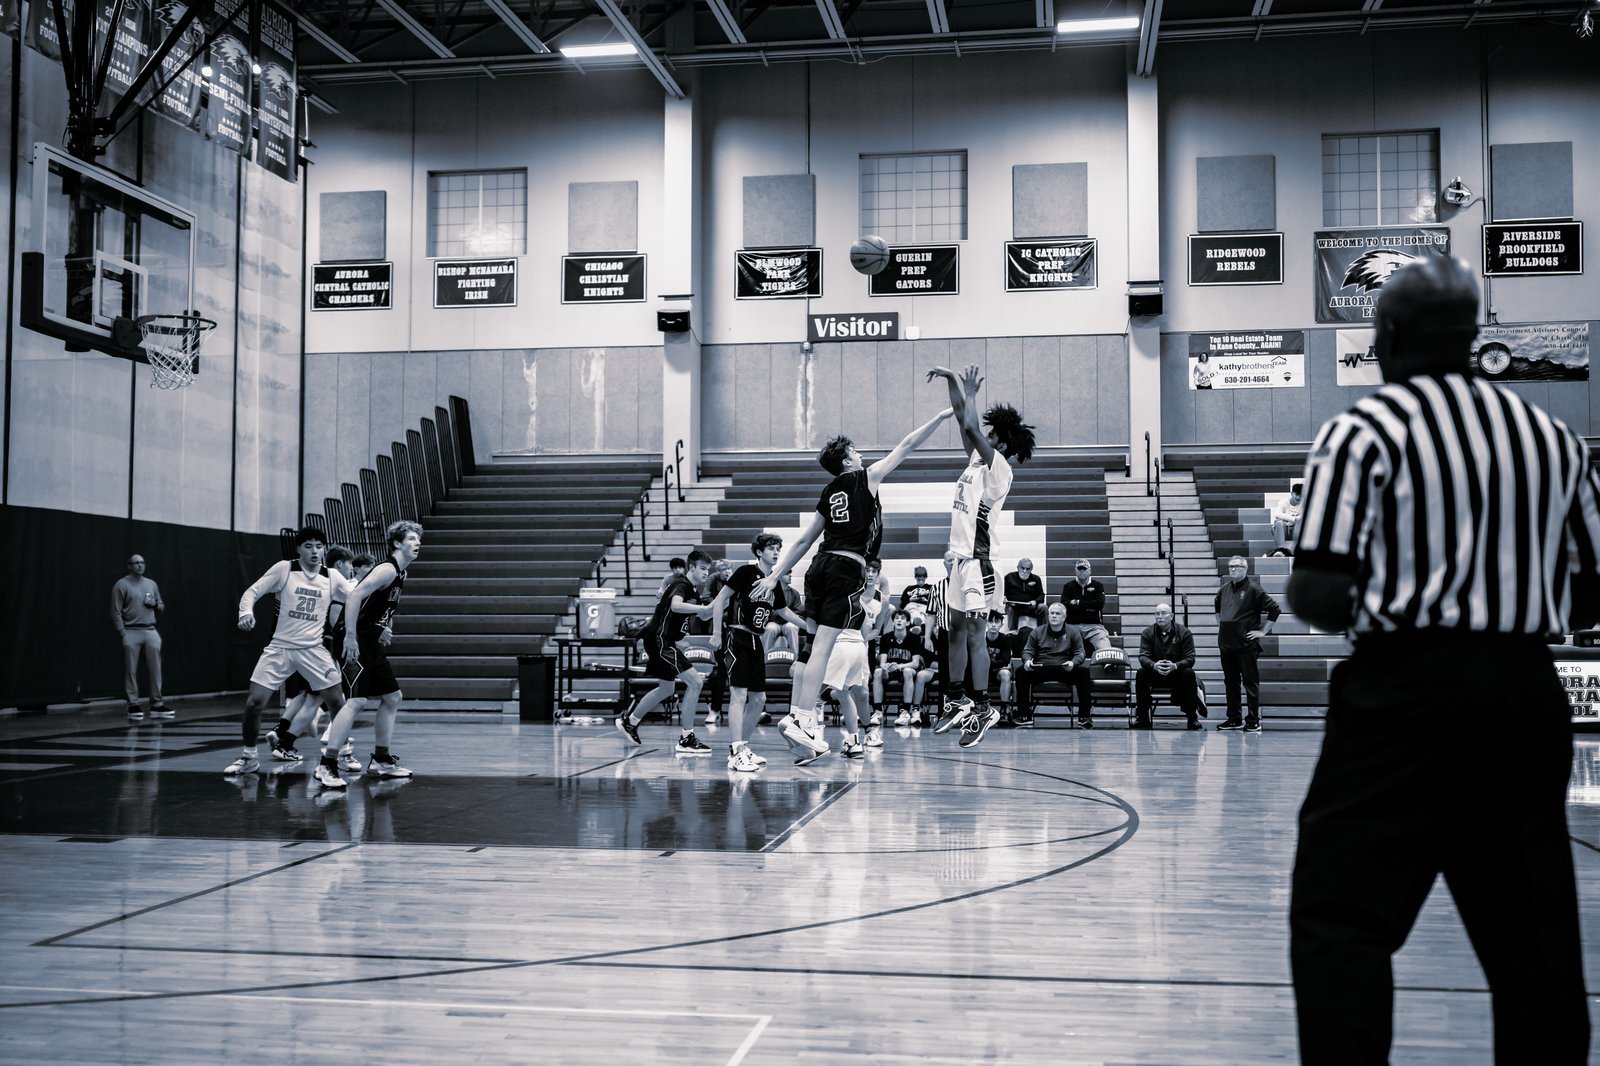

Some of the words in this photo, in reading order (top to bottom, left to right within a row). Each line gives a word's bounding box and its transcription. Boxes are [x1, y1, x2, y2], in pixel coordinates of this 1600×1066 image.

[261, 3, 294, 42] AURORA
[163, 94, 192, 118] FOOTBALL
[218, 123, 244, 144] FOOTBALL
[1503, 231, 1561, 241] RIVERSIDE
[1317, 238, 1363, 248] WELCOME
[1367, 238, 1378, 246] TO
[1382, 236, 1401, 246] THE
[1404, 235, 1432, 246] HOME
[1433, 235, 1448, 245] OF
[1035, 247, 1081, 258] CATHOLIC
[1206, 248, 1266, 258] RIDGEWOOD
[1499, 244, 1565, 255] BROOKFIELD
[896, 252, 933, 262] GUERIN
[1506, 257, 1559, 267] BULLDOGS
[585, 262, 623, 271] CHICAGO
[756, 257, 801, 269] ELMWOOD
[1038, 261, 1064, 270] PREP
[1216, 261, 1256, 271] REBELS
[334, 270, 369, 279] AURORA
[438, 267, 467, 276] BISHOP
[468, 265, 514, 276] MCNAMARA
[766, 269, 791, 279] PARK
[901, 266, 927, 275] PREP
[579, 274, 629, 285] CHRISTIAN
[1030, 272, 1073, 283] KNIGHTS
[315, 283, 350, 292] CENTRAL
[352, 282, 389, 291] CATHOLIC
[457, 278, 496, 288] FIGHTING
[761, 282, 797, 291] TIGERS
[896, 279, 932, 289] GATORS
[465, 291, 488, 300] IRISH
[584, 287, 624, 297] KNIGHTS
[328, 294, 375, 304] CHARGERS
[1329, 296, 1373, 308] AURORA
[814, 317, 892, 338] Visitor
[1210, 336, 1221, 344] Top
[1264, 334, 1283, 342] Team
[1260, 341, 1281, 349] AGAIN!
[1219, 362, 1274, 371] kathybrothers
[829, 491, 849, 523] 2
[296, 596, 317, 613] 20
[288, 610, 319, 622] CENTRAL
[587, 605, 599, 617] G
[684, 649, 711, 660] CHRISTIAN
[767, 650, 795, 661] CHRISTIAN
[1095, 651, 1124, 661] CHRISTIAN
[1570, 666, 1582, 674] TO
